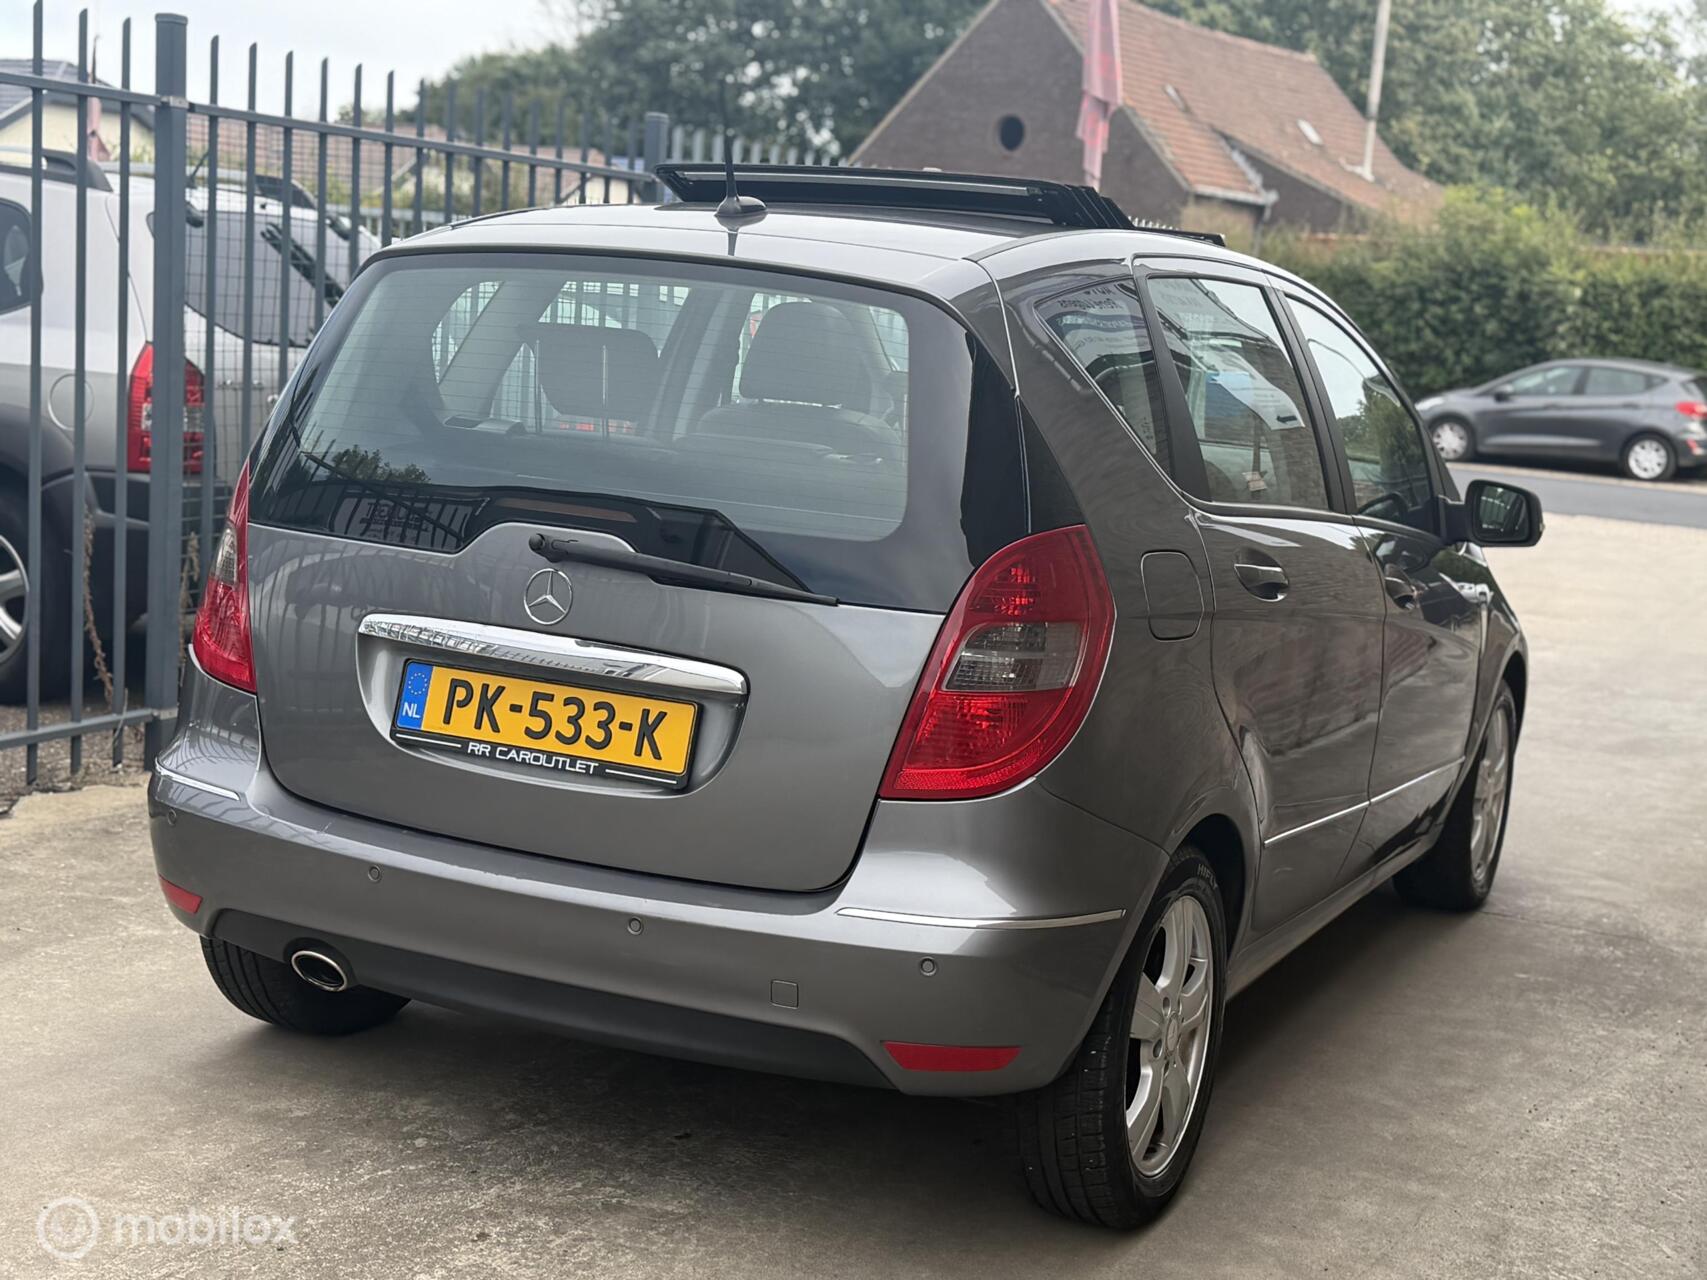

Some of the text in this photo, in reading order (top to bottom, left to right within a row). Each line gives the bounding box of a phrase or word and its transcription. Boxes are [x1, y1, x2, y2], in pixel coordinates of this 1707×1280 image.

[402, 702, 421, 719] NL
[442, 678, 668, 760] PK-533-K
[467, 742, 599, 774] RR CAROUTLET
